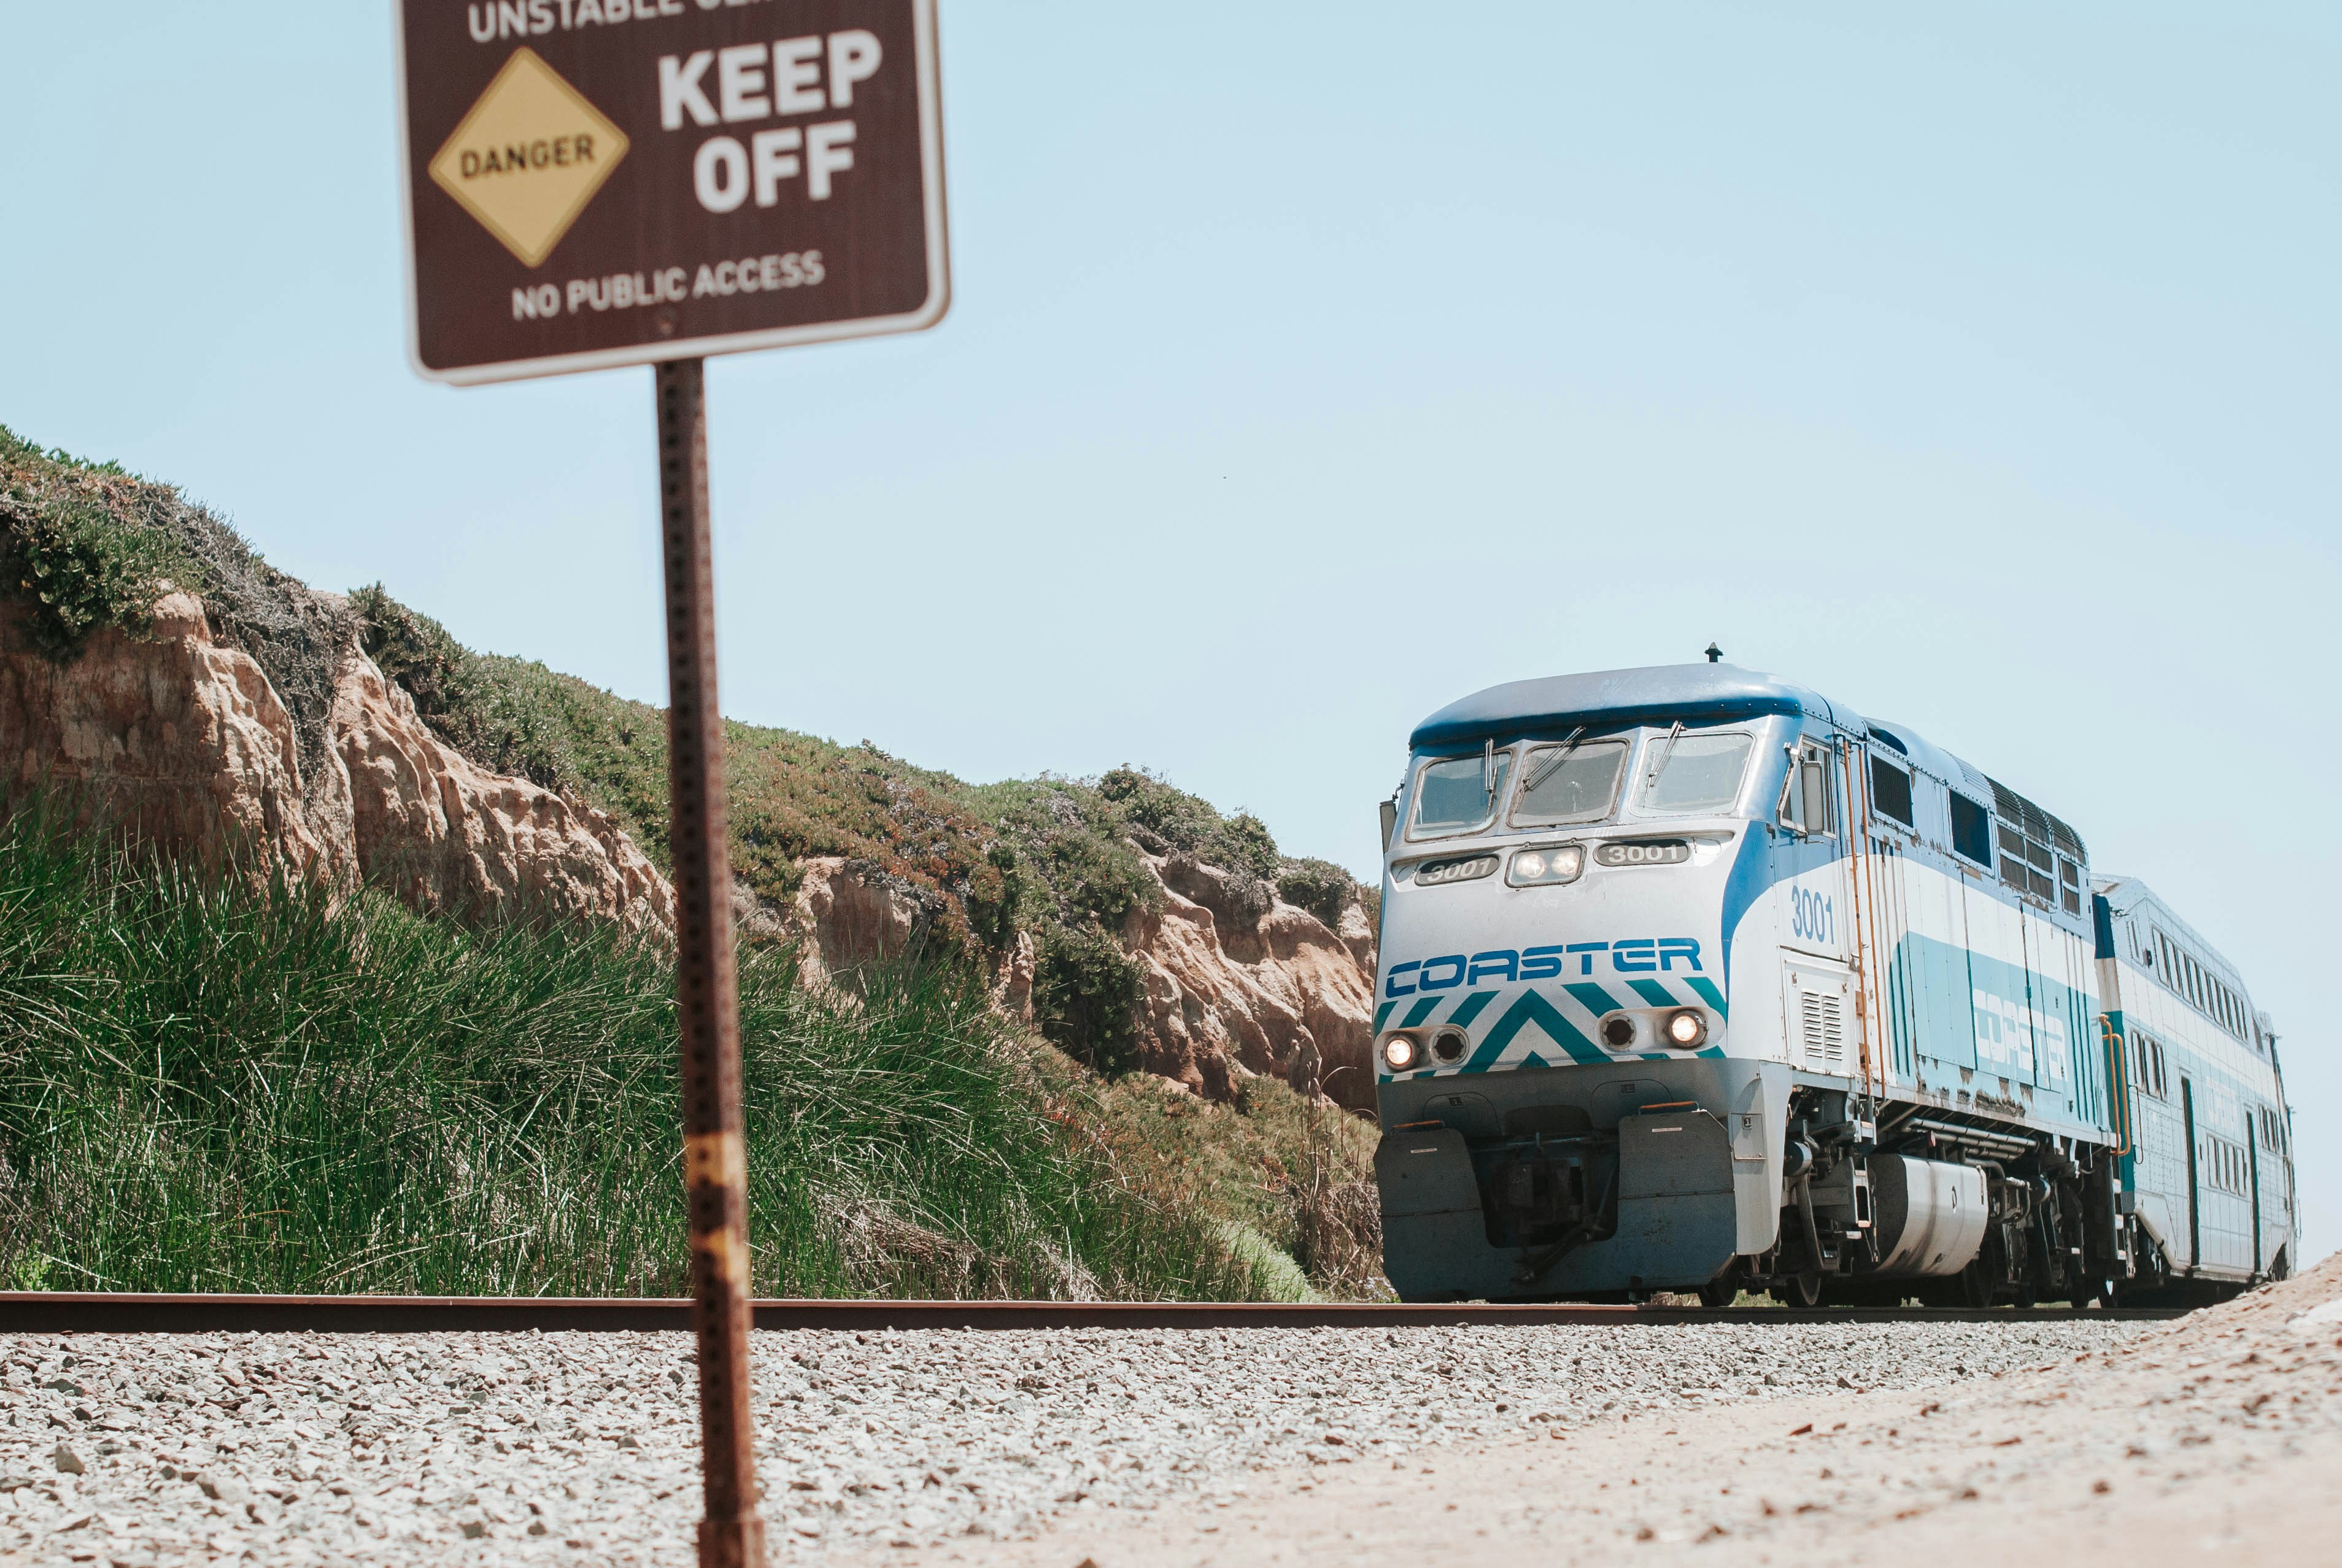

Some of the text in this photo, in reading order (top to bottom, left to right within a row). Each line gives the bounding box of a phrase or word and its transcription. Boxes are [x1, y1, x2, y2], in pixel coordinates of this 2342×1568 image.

[658, 29, 883, 131] KEEP
[462, 134, 595, 179] DANGER
[693, 120, 857, 213] OFF
[512, 250, 825, 320] NO PUBLIC ACCESS
[1427, 859, 1492, 882] 3001
[1609, 844, 1677, 863] 3001
[1791, 885, 1834, 944] 3001
[1385, 937, 1703, 998] COASTER
[1973, 988, 2068, 1083] COASTER
